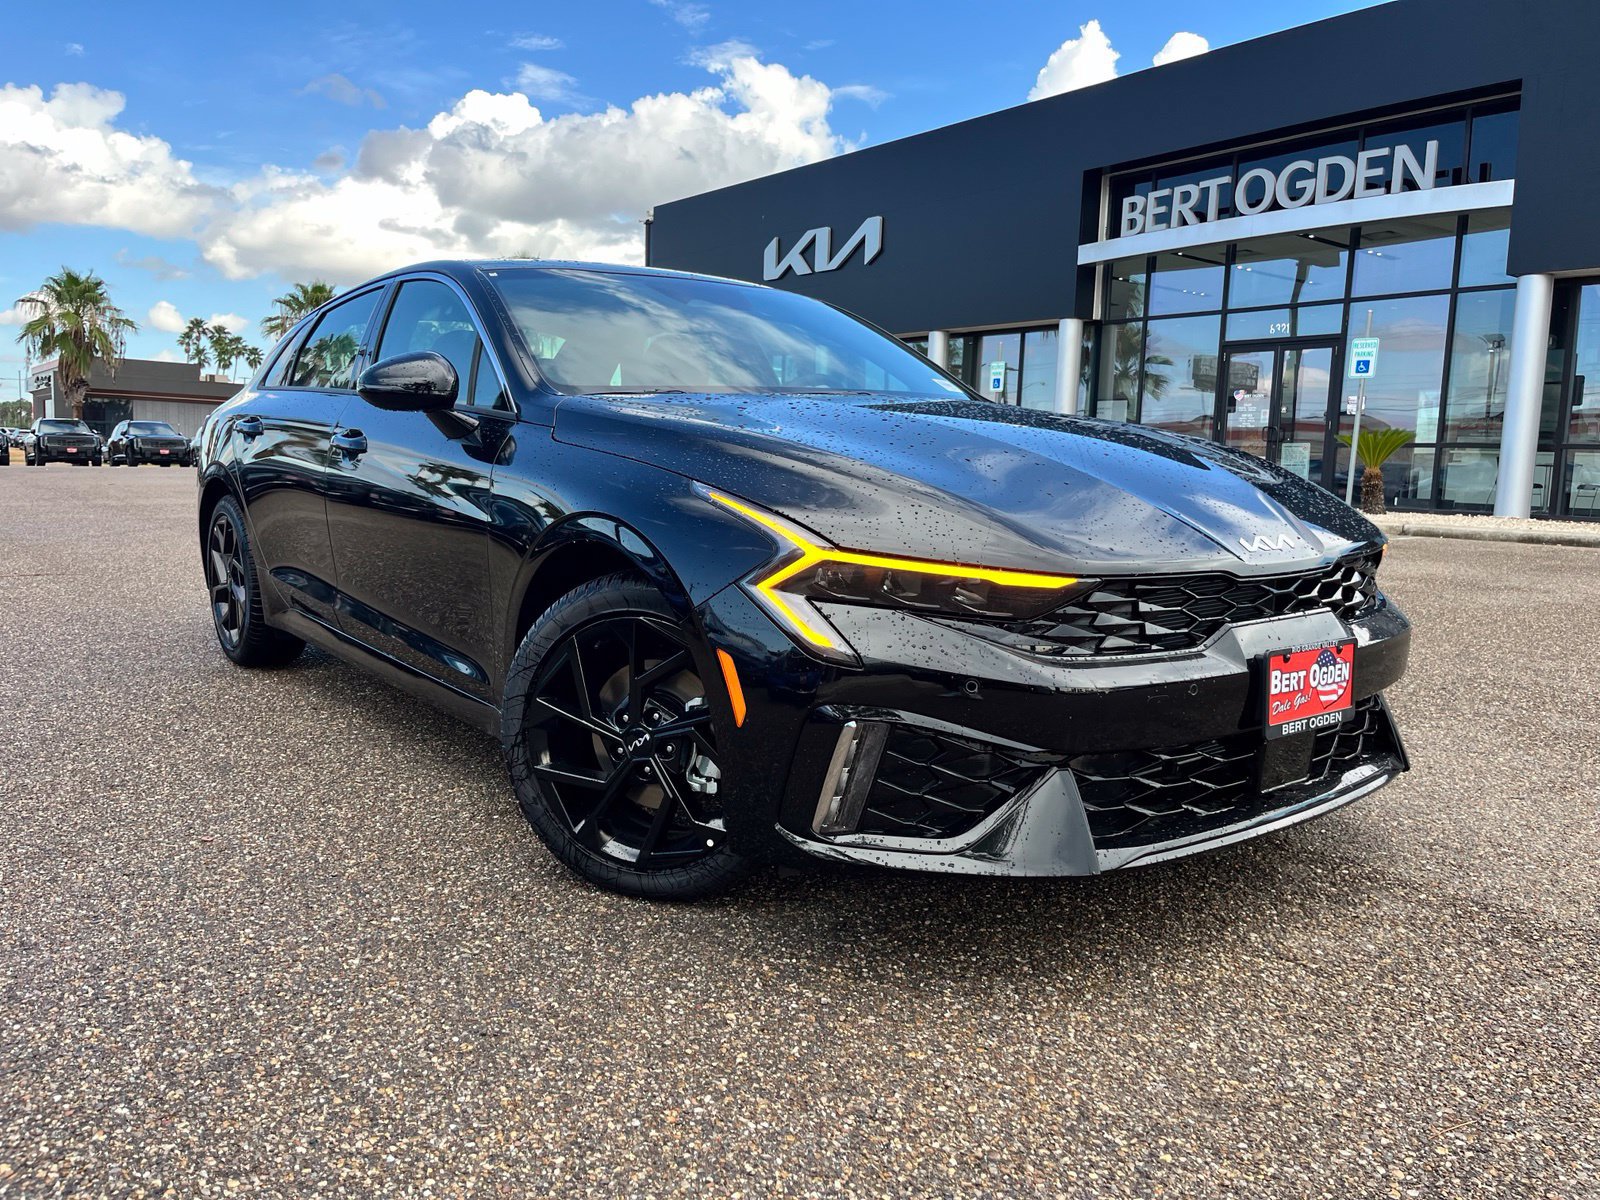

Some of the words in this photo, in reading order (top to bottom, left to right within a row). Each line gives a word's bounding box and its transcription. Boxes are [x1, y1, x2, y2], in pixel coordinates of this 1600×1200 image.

[1121, 175, 1231, 238] BERT
[1235, 140, 1439, 216] OGDEN
[763, 215, 884, 281] KIA
[1353, 341, 1378, 349] RESERVED
[1354, 350, 1375, 358] PARKING
[1239, 533, 1295, 552] KIA
[1270, 670, 1307, 695] BERT
[1309, 662, 1350, 688] OGDEN
[1272, 699, 1292, 716] Dale
[1282, 719, 1308, 736] BERT
[1309, 711, 1342, 729] OGDEN
